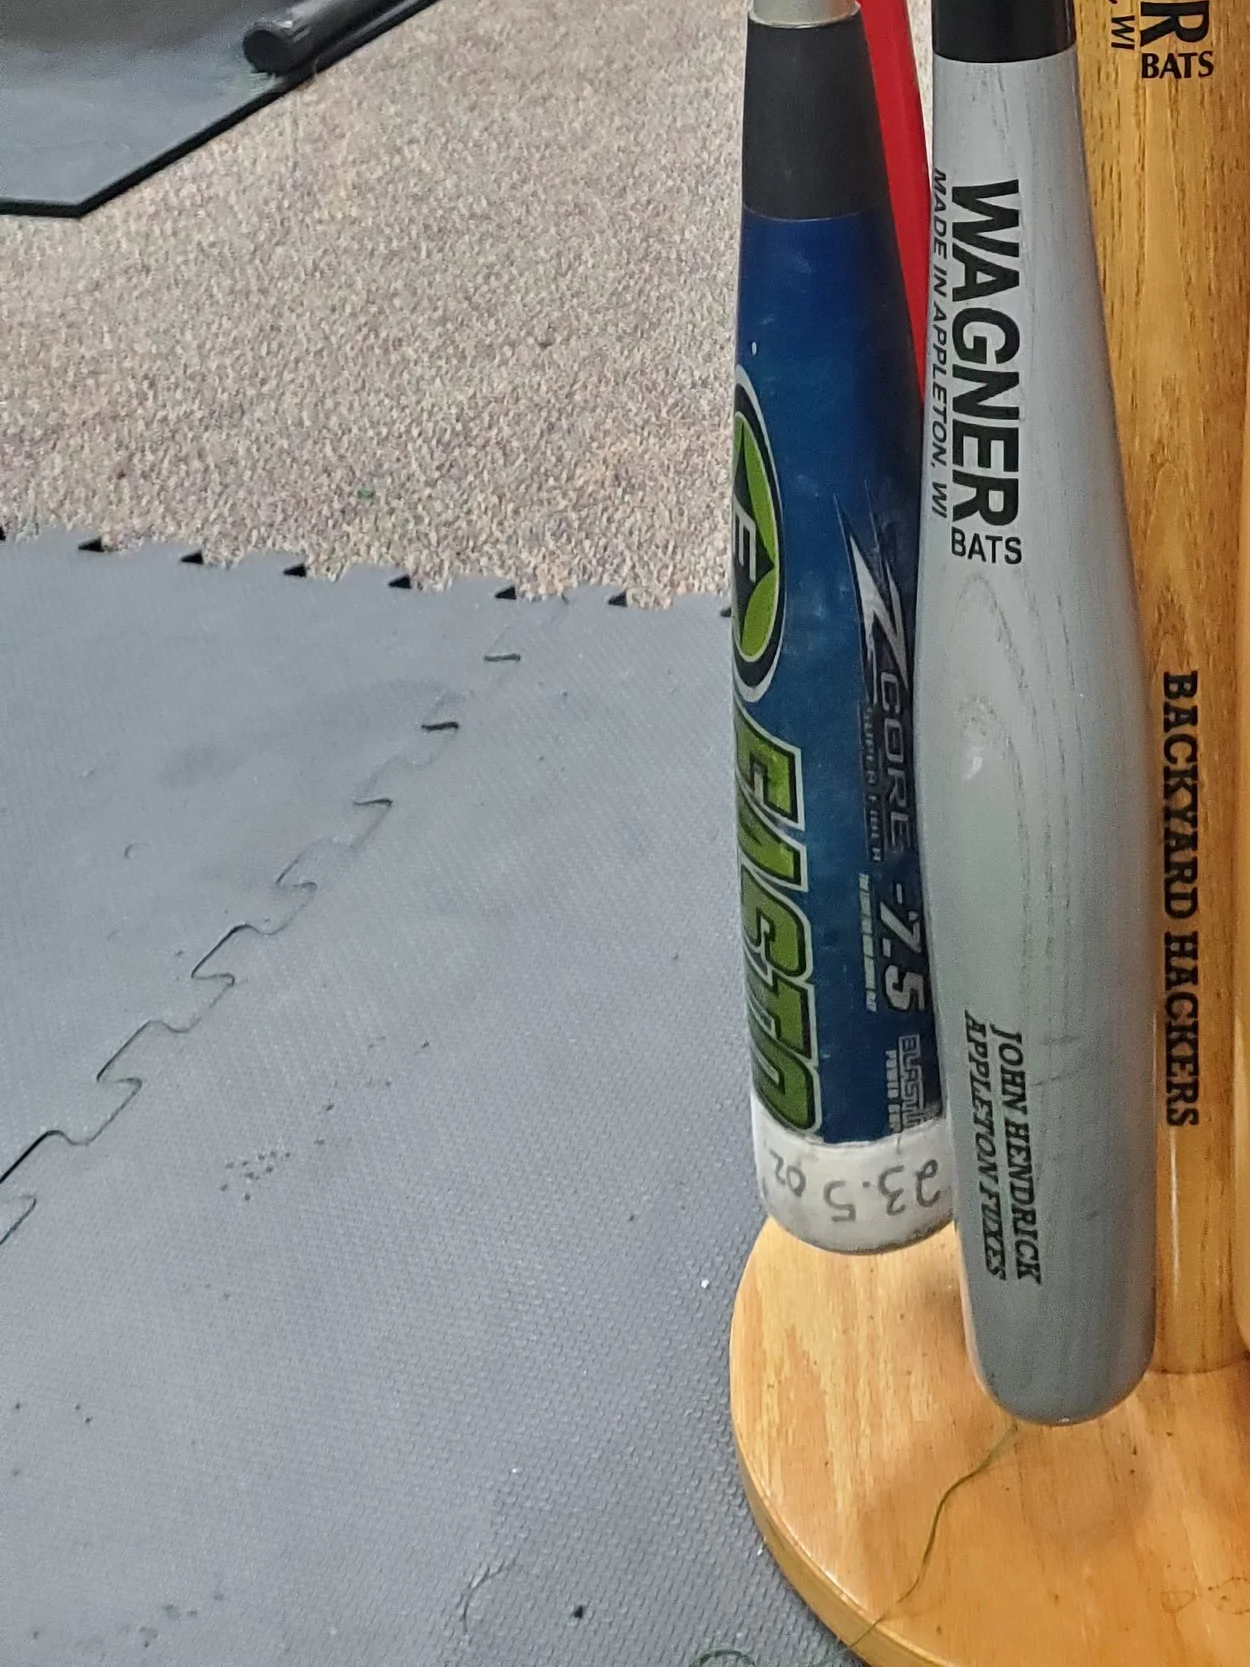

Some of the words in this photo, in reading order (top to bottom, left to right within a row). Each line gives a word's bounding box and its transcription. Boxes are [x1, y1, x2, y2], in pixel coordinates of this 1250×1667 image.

[1111, 15, 1135, 50] WI
[1141, 51, 1214, 79] BATS
[933, 168, 948, 260] MADE
[933, 264, 948, 299] IN
[952, 179, 1020, 526] WAGNER
[931, 481, 948, 519] WI
[951, 526, 1022, 564] BATS
[1163, 670, 1198, 920] BACKYARD
[879, 883, 927, 1012] -7.5
[990, 1023, 1028, 1115] JOHN
[1164, 931, 1200, 1128] HACKERS
[965, 1009, 1000, 1185] APPLETON
[824, 1159, 941, 1223] 23.5
[1004, 1117, 1042, 1285] HENDRICK
